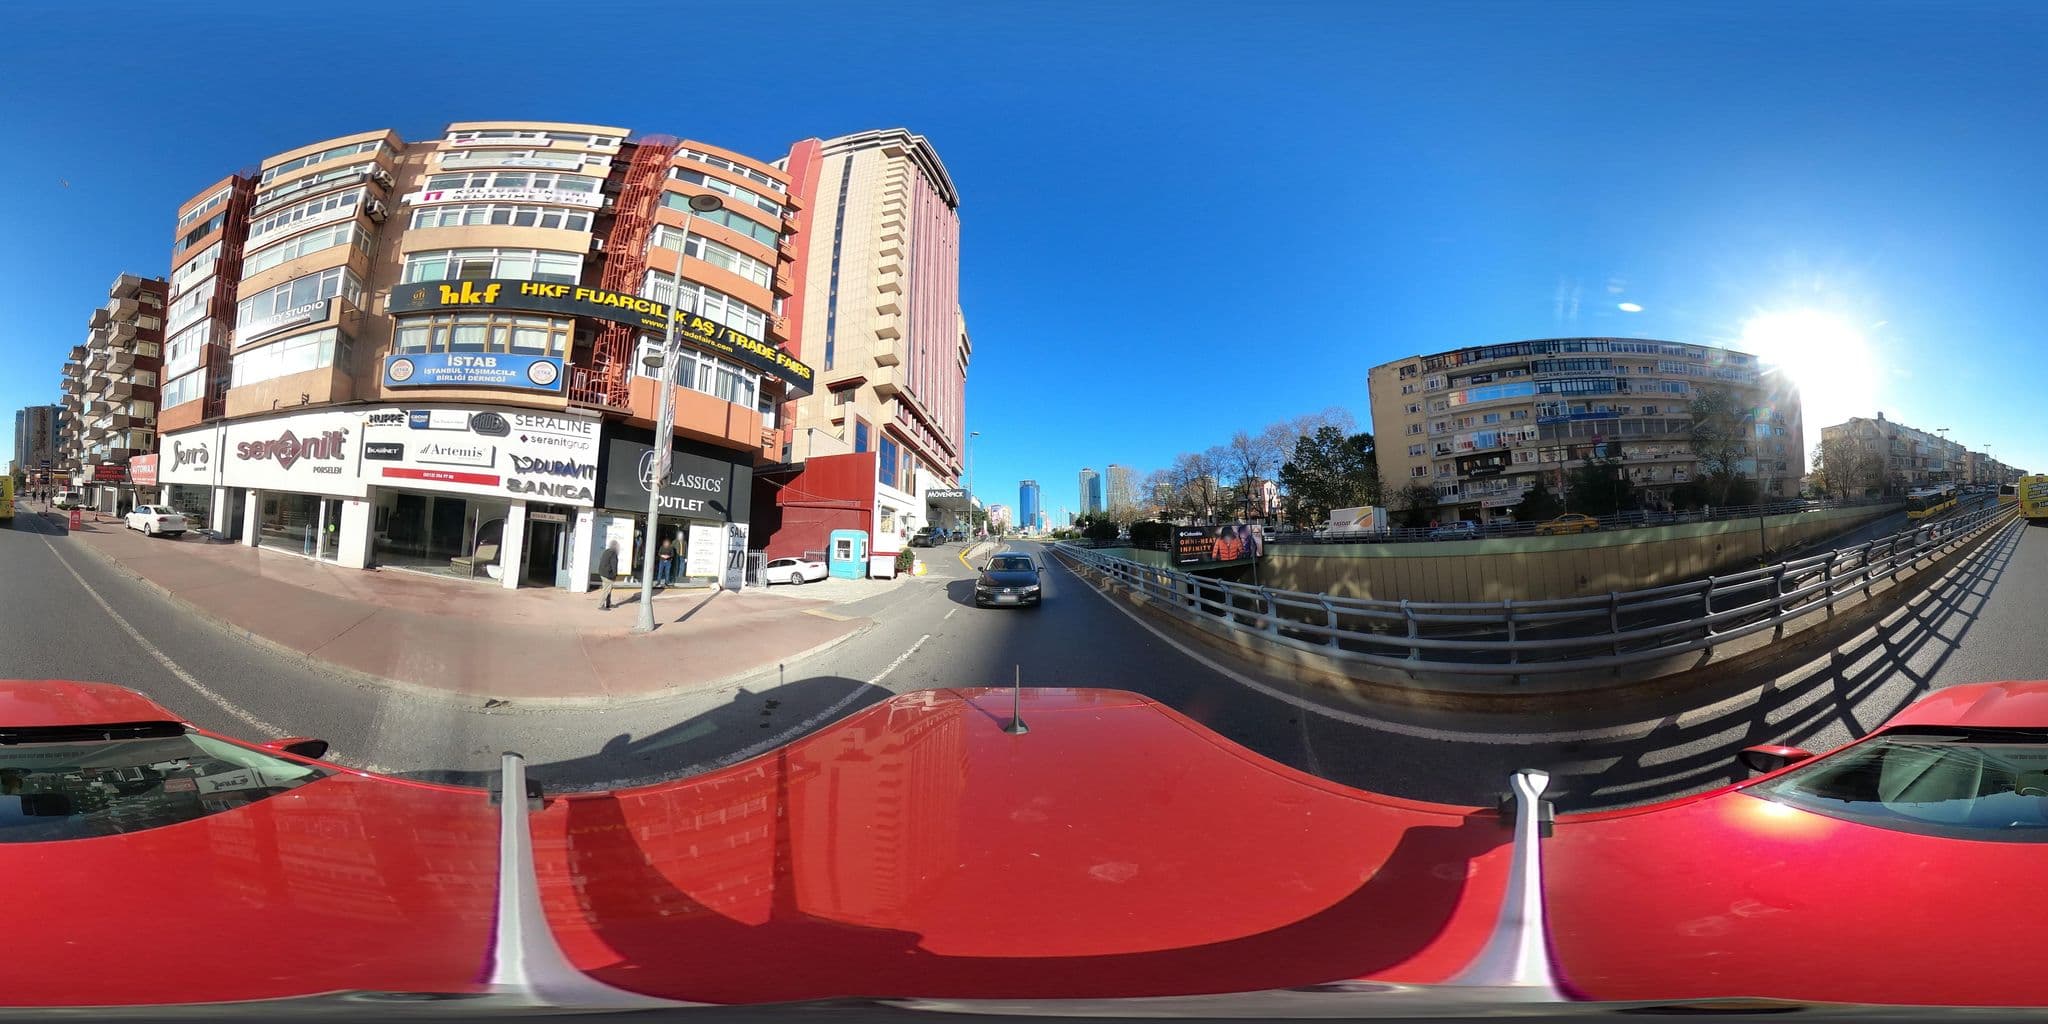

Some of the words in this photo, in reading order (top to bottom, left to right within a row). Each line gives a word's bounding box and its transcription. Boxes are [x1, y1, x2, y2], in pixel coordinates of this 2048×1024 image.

[439, 281, 502, 305] hkf
[285, 301, 325, 317] STUDIO
[520, 282, 571, 298] HKF
[575, 287, 689, 325] FUARCILK.
[727, 329, 778, 362] TRADE
[776, 352, 812, 381] FAIRS
[447, 354, 497, 367] İSTAB
[423, 366, 463, 375] İSTANBUL
[515, 414, 592, 434] SERALINE
[236, 429, 346, 466] seranit
[431, 443, 483, 458] Artemis
[530, 435, 590, 450] seranitgrup
[533, 457, 597, 481] DURAVIT
[506, 477, 594, 502] SANICA
[656, 495, 704, 512] OUTLET
